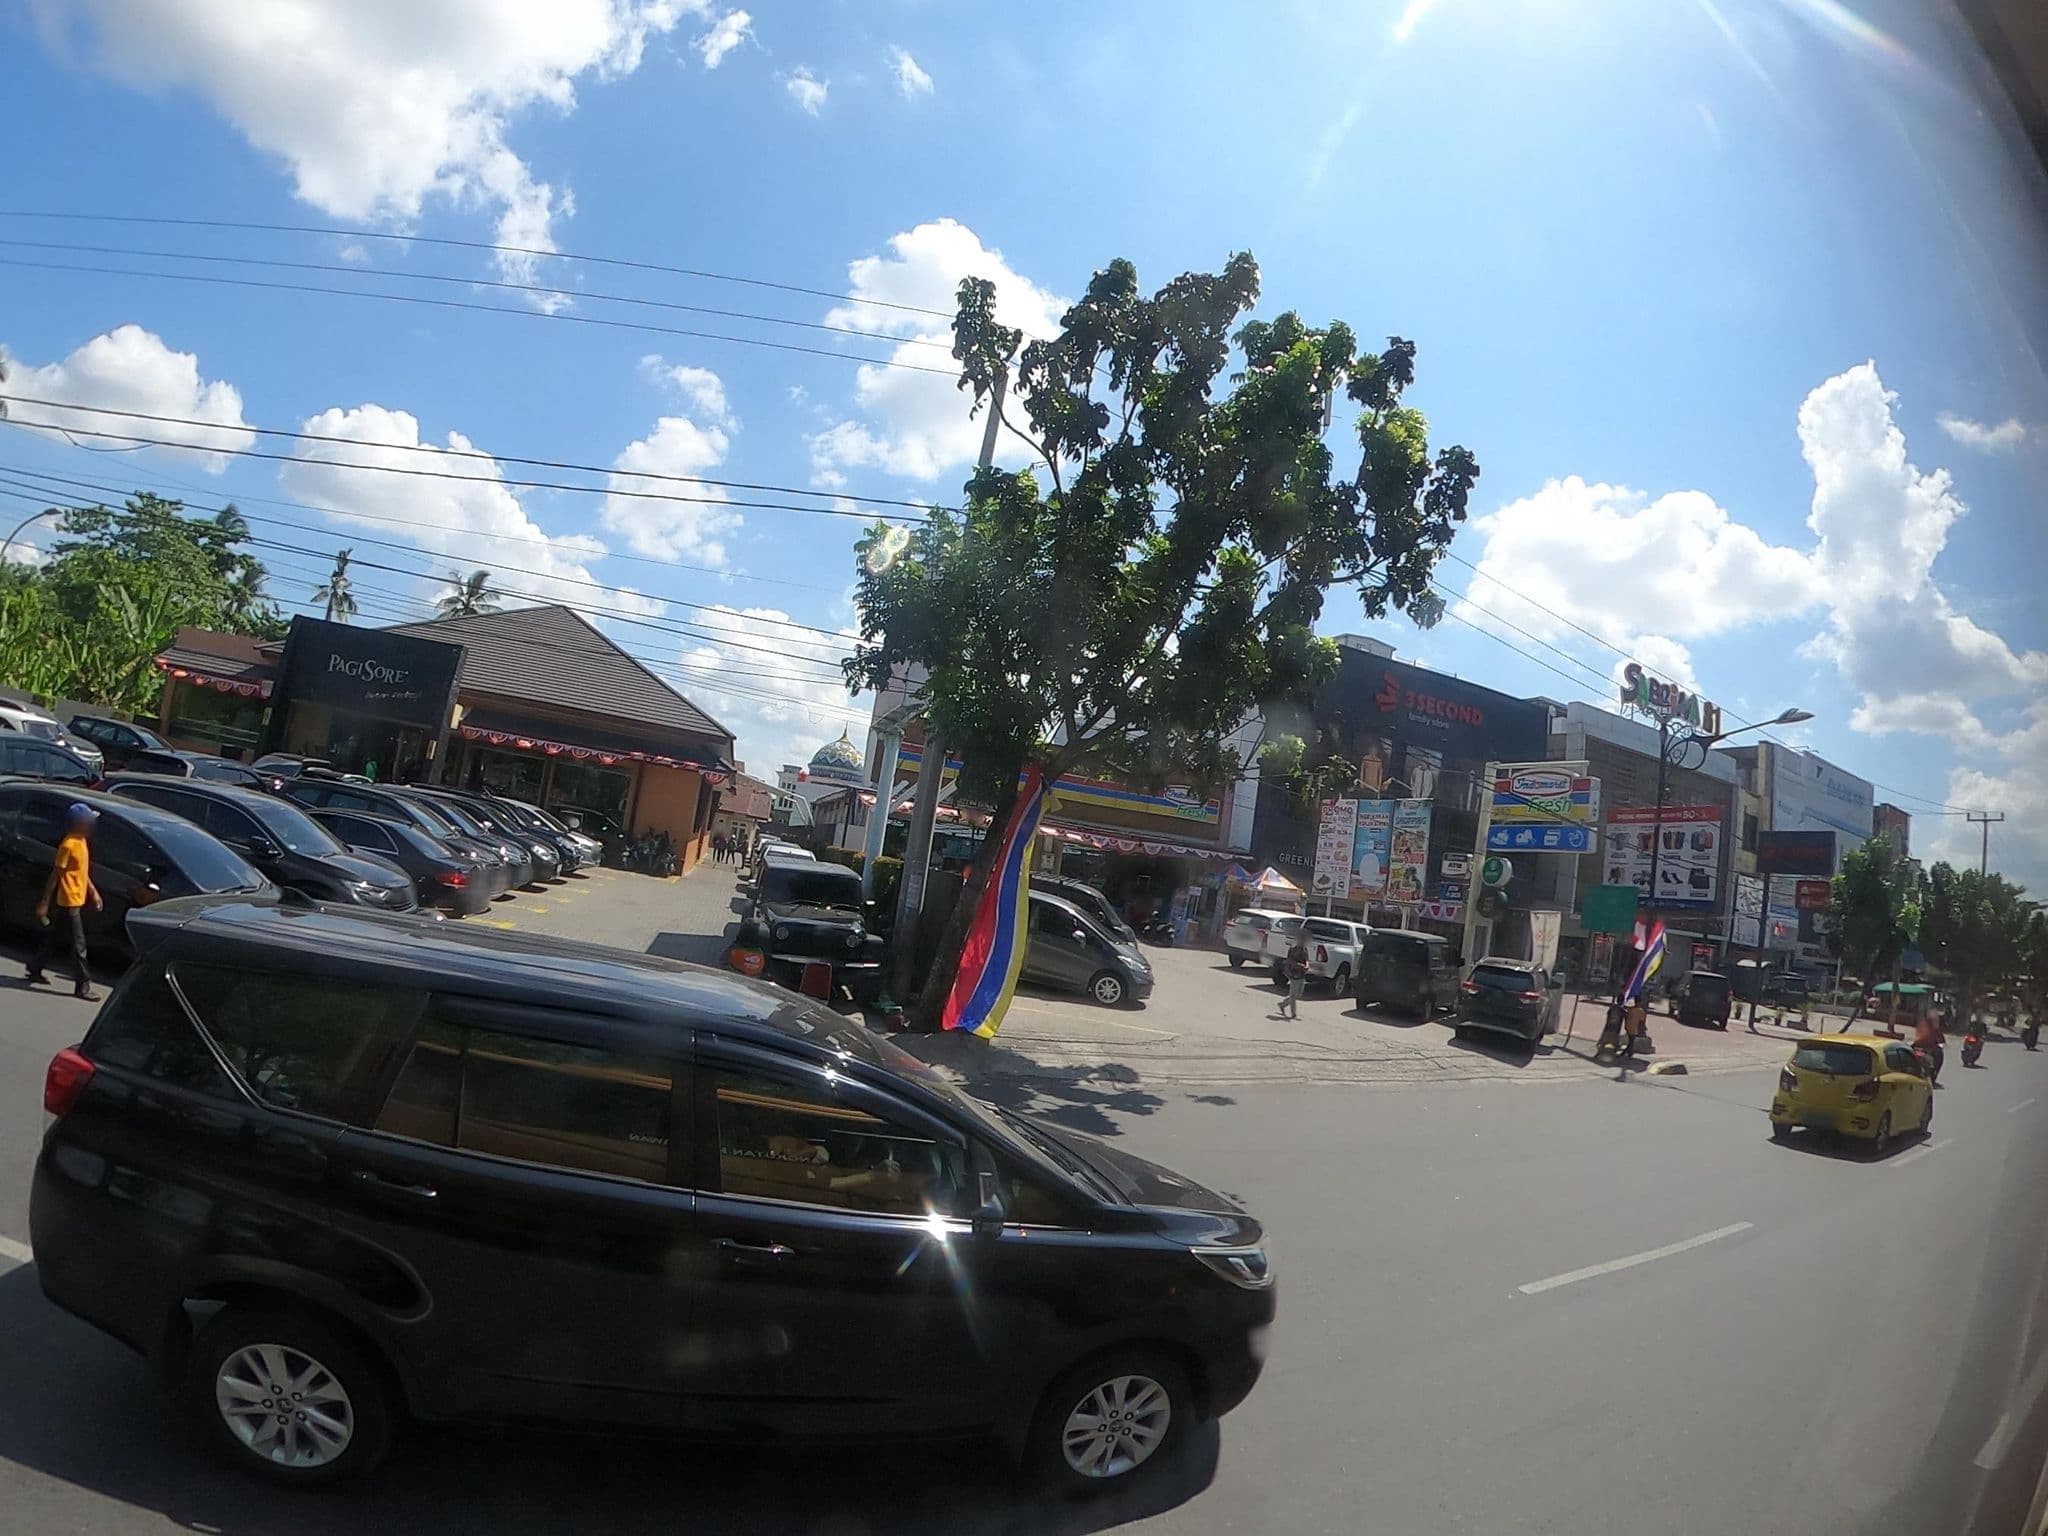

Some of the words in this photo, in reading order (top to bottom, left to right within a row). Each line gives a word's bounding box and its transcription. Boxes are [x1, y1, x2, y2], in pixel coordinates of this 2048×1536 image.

[1405, 690, 1483, 725] 3SECOND
[1176, 804, 1207, 820] Fresh
[1527, 797, 1571, 812] Fresh
